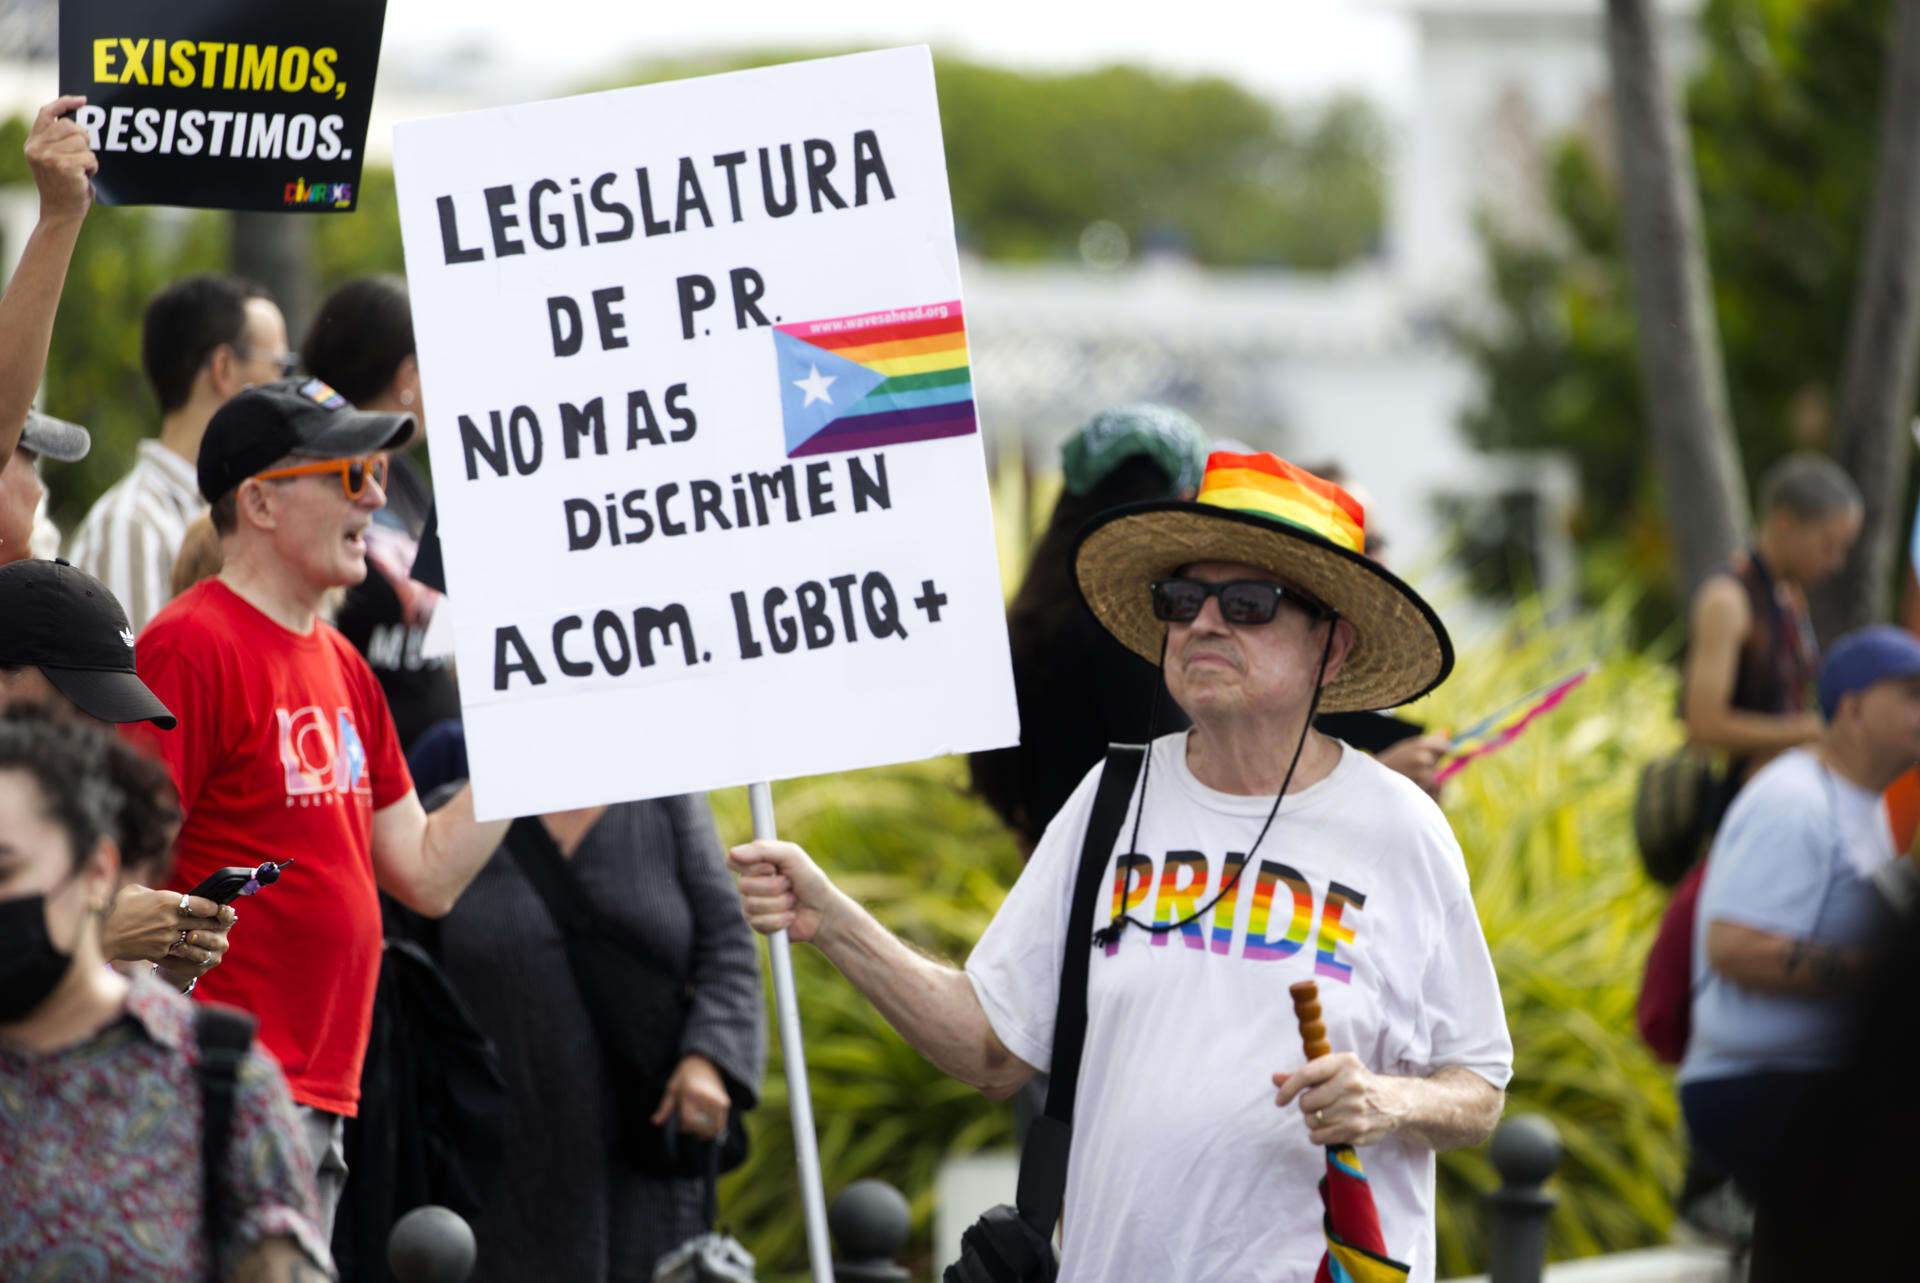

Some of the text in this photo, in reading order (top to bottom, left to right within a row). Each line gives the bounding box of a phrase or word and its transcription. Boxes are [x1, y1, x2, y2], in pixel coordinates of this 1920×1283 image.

[93, 37, 347, 100] EXISTIMOS,
[75, 104, 353, 161] RESISTIMOS.
[546, 286, 630, 358] DE
[810, 304, 949, 334] www.wavesahead.org
[457, 382, 698, 481] NO MAS
[1104, 850, 1367, 985] PRIDE
